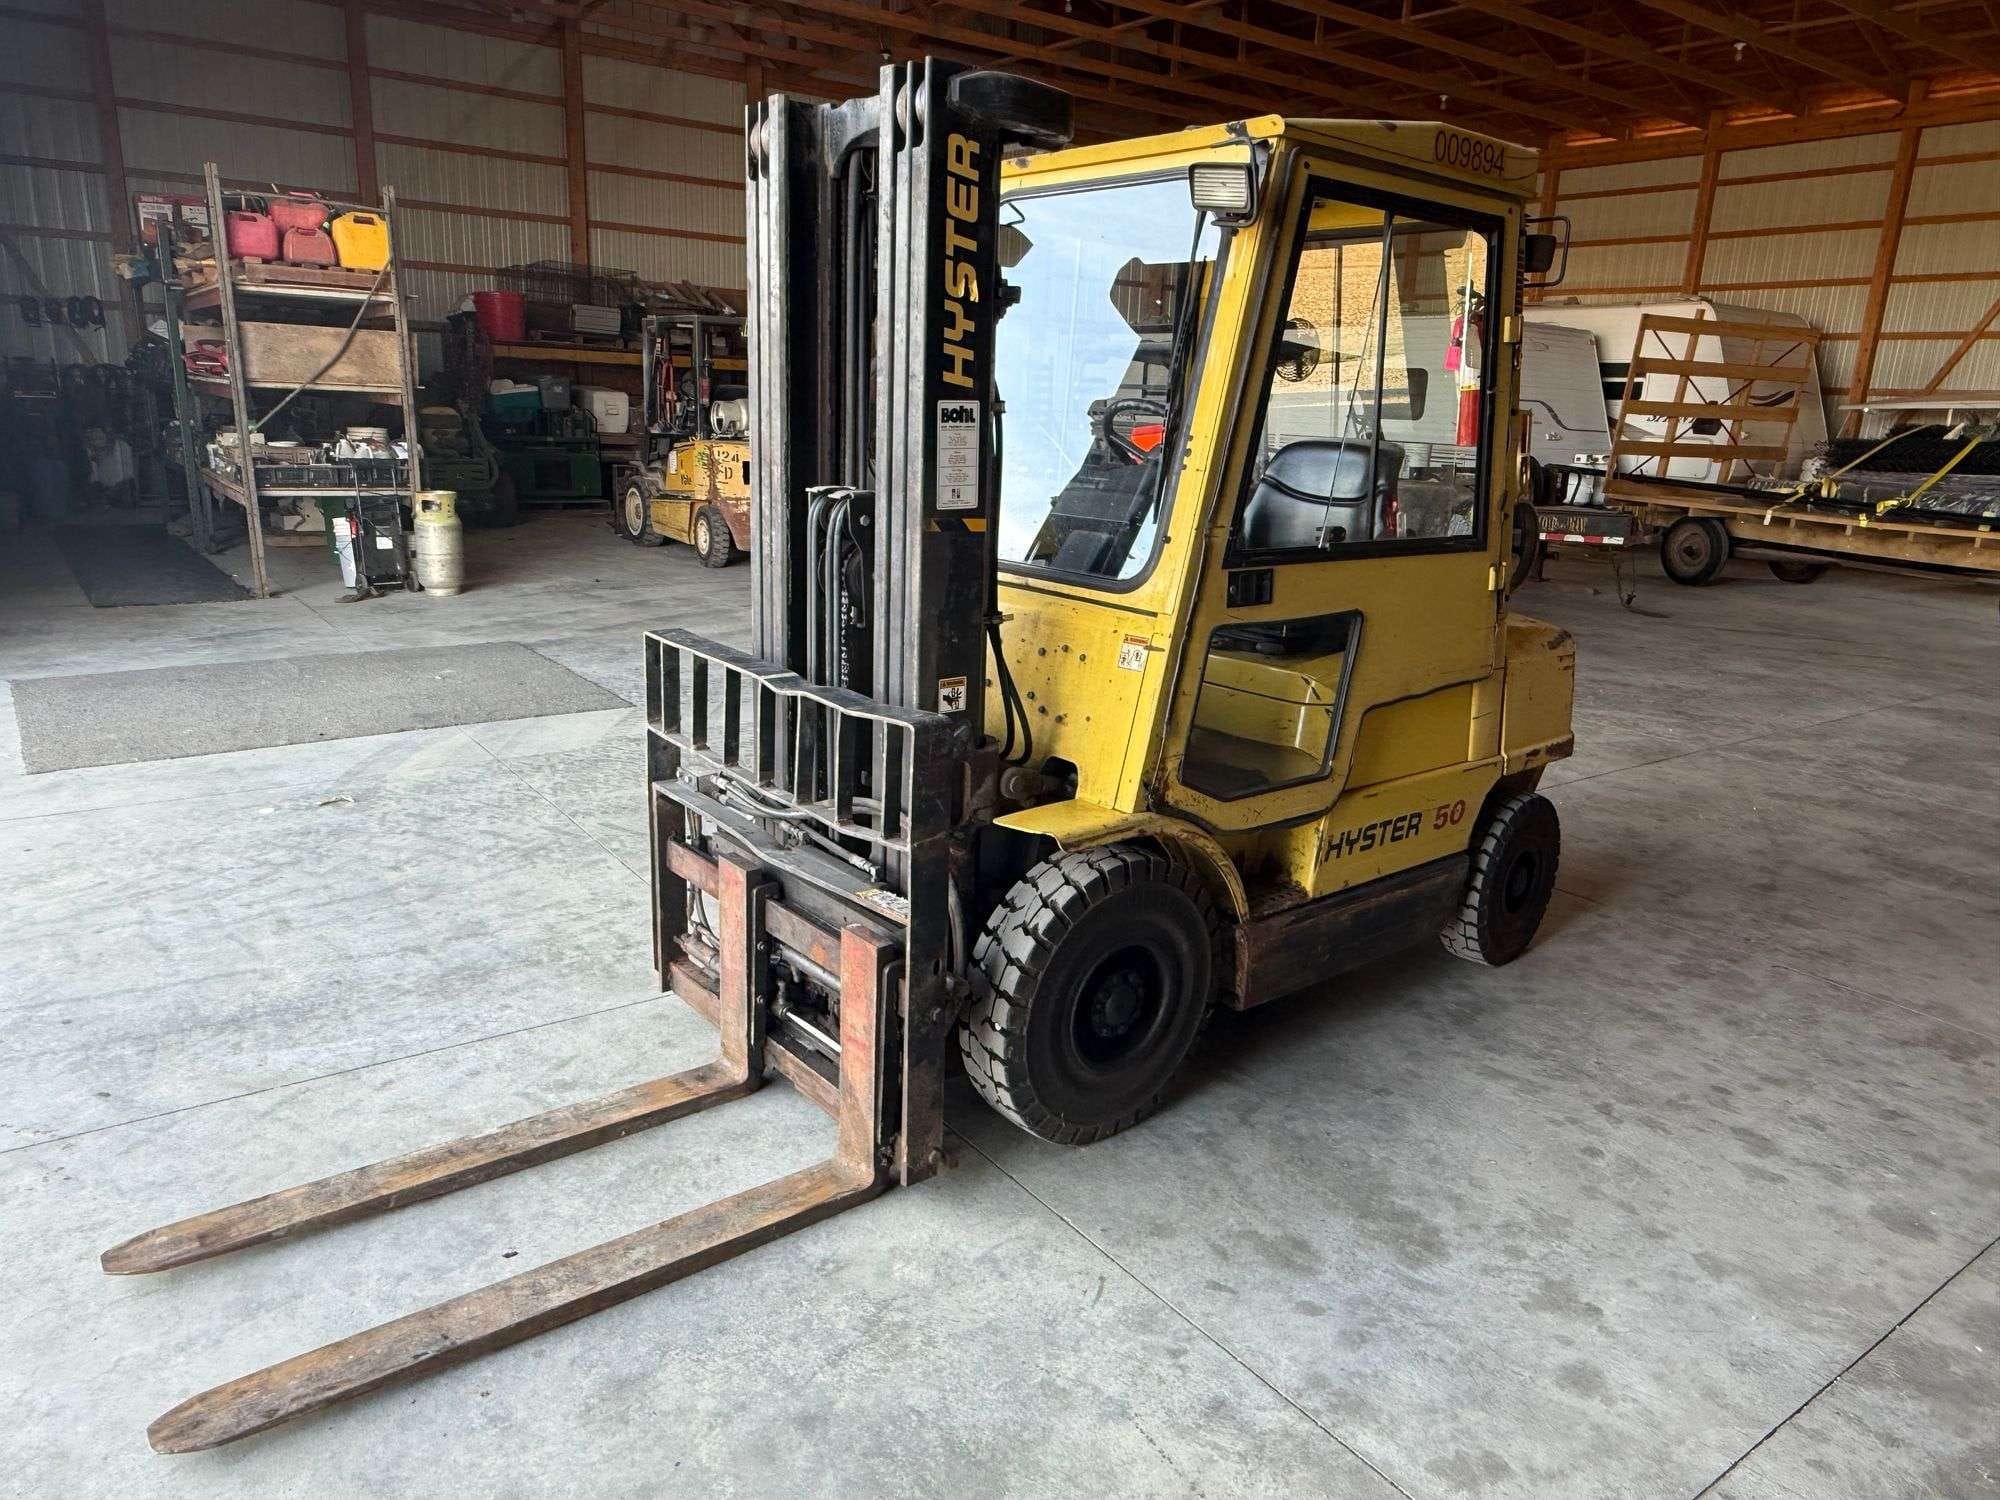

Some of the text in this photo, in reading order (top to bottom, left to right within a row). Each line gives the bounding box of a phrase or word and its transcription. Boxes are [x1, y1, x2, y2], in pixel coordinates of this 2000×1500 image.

[1434, 129, 1505, 177] 009894
[943, 133, 980, 388] HYSTER
[1323, 799, 1467, 863] HYSTER 50
